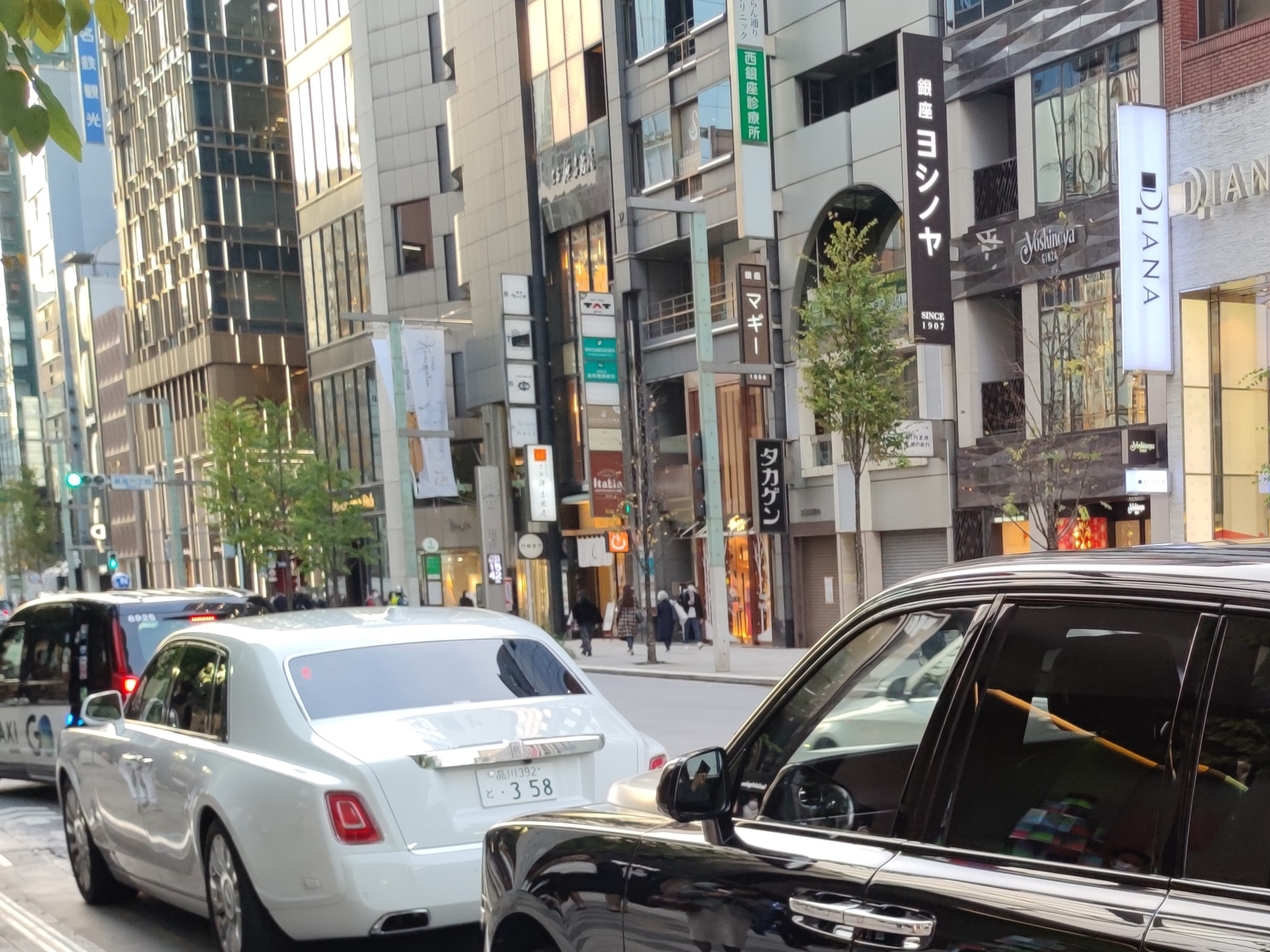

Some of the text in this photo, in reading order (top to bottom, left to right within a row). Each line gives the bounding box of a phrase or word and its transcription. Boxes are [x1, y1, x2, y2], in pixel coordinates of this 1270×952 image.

[744, 51, 760, 140] 西銀座診療所
[917, 78, 940, 256] 銀座 ヨシノヤ
[1137, 188, 1164, 305] DIANA
[746, 293, 764, 355] マギー
[921, 311, 945, 320] SINCE
[922, 321, 944, 330] 1907
[760, 448, 780, 525] タカゲン
[487, 789, 494, 799] と
